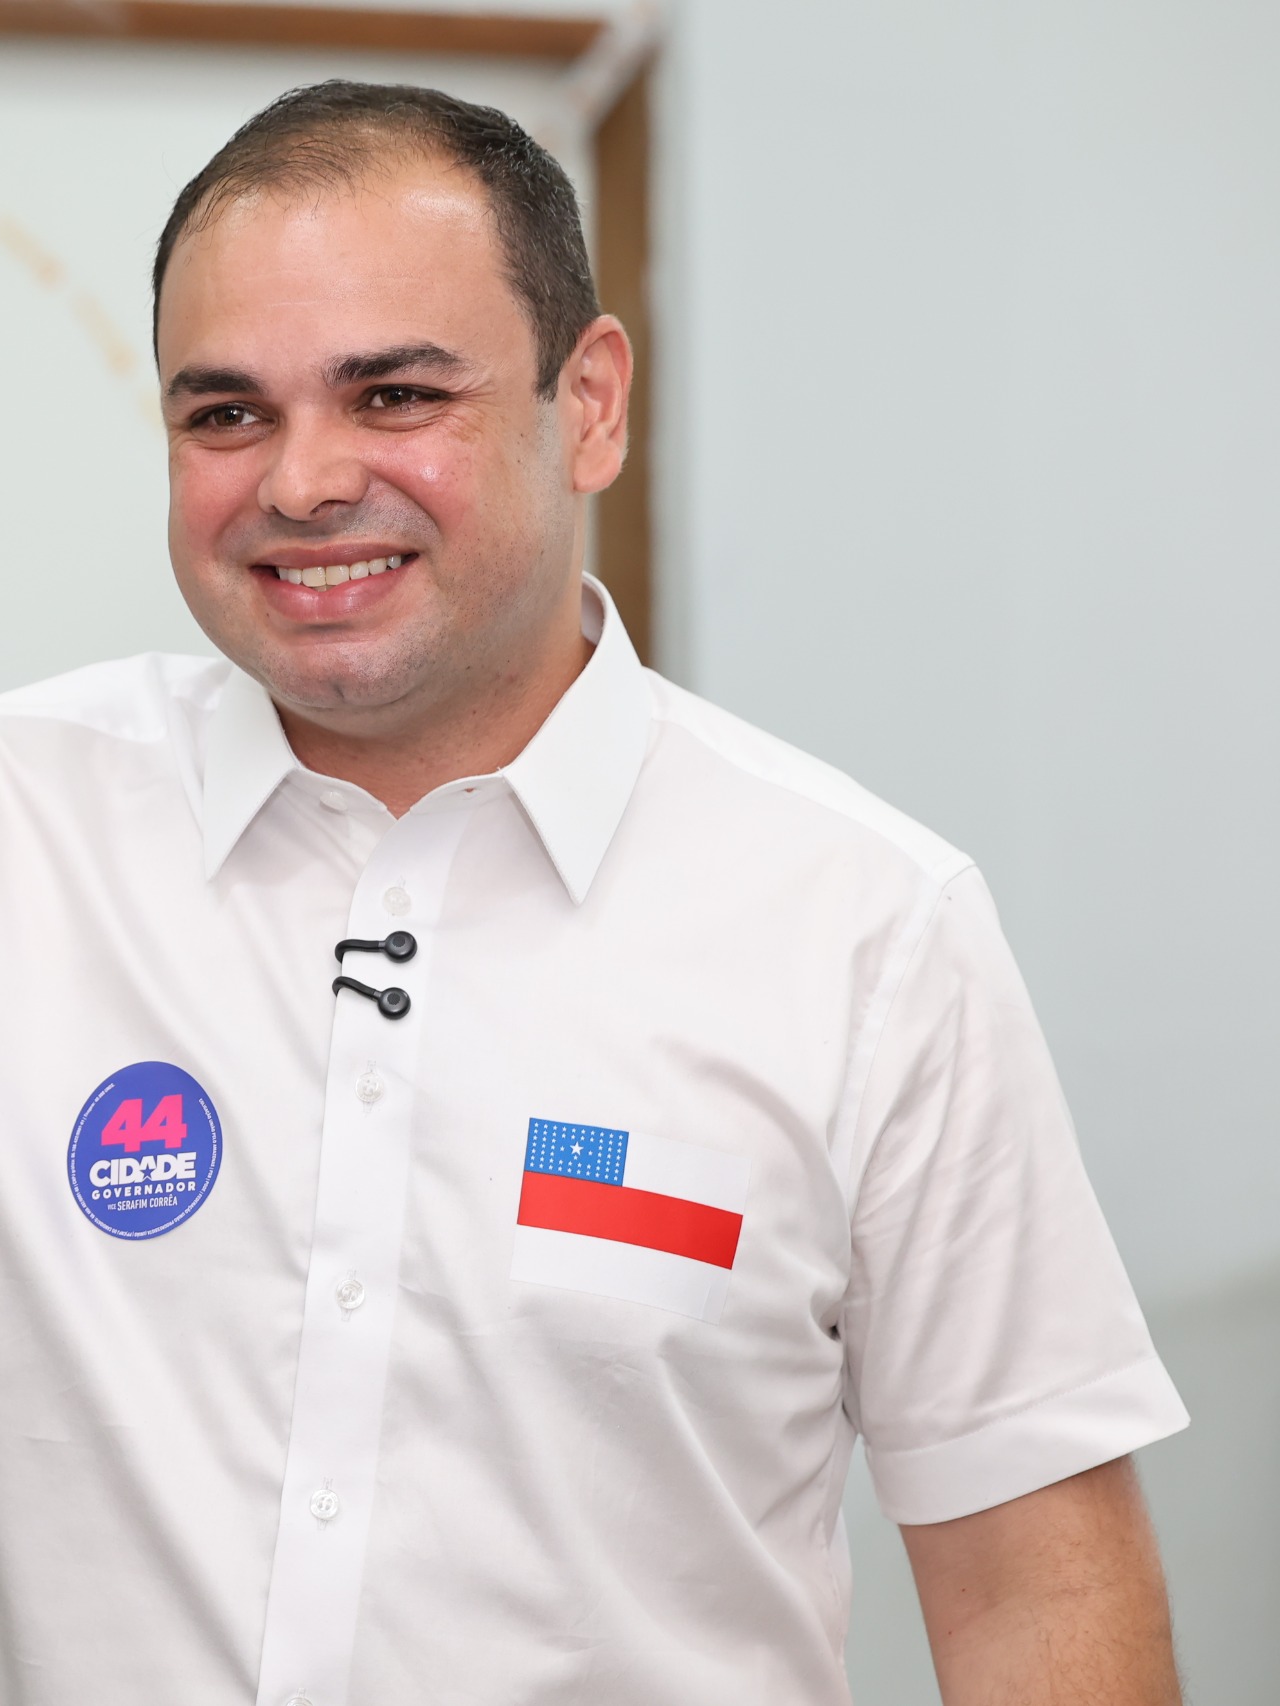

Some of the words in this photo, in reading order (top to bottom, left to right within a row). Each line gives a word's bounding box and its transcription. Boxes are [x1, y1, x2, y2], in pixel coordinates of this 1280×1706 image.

[101, 1094, 188, 1153] 44
[89, 1152, 197, 1188] CIDADE
[91, 1181, 196, 1200] GOVERNADOR
[117, 1198, 148, 1211] SERAFIM
[149, 1194, 178, 1208] CORRÊA
